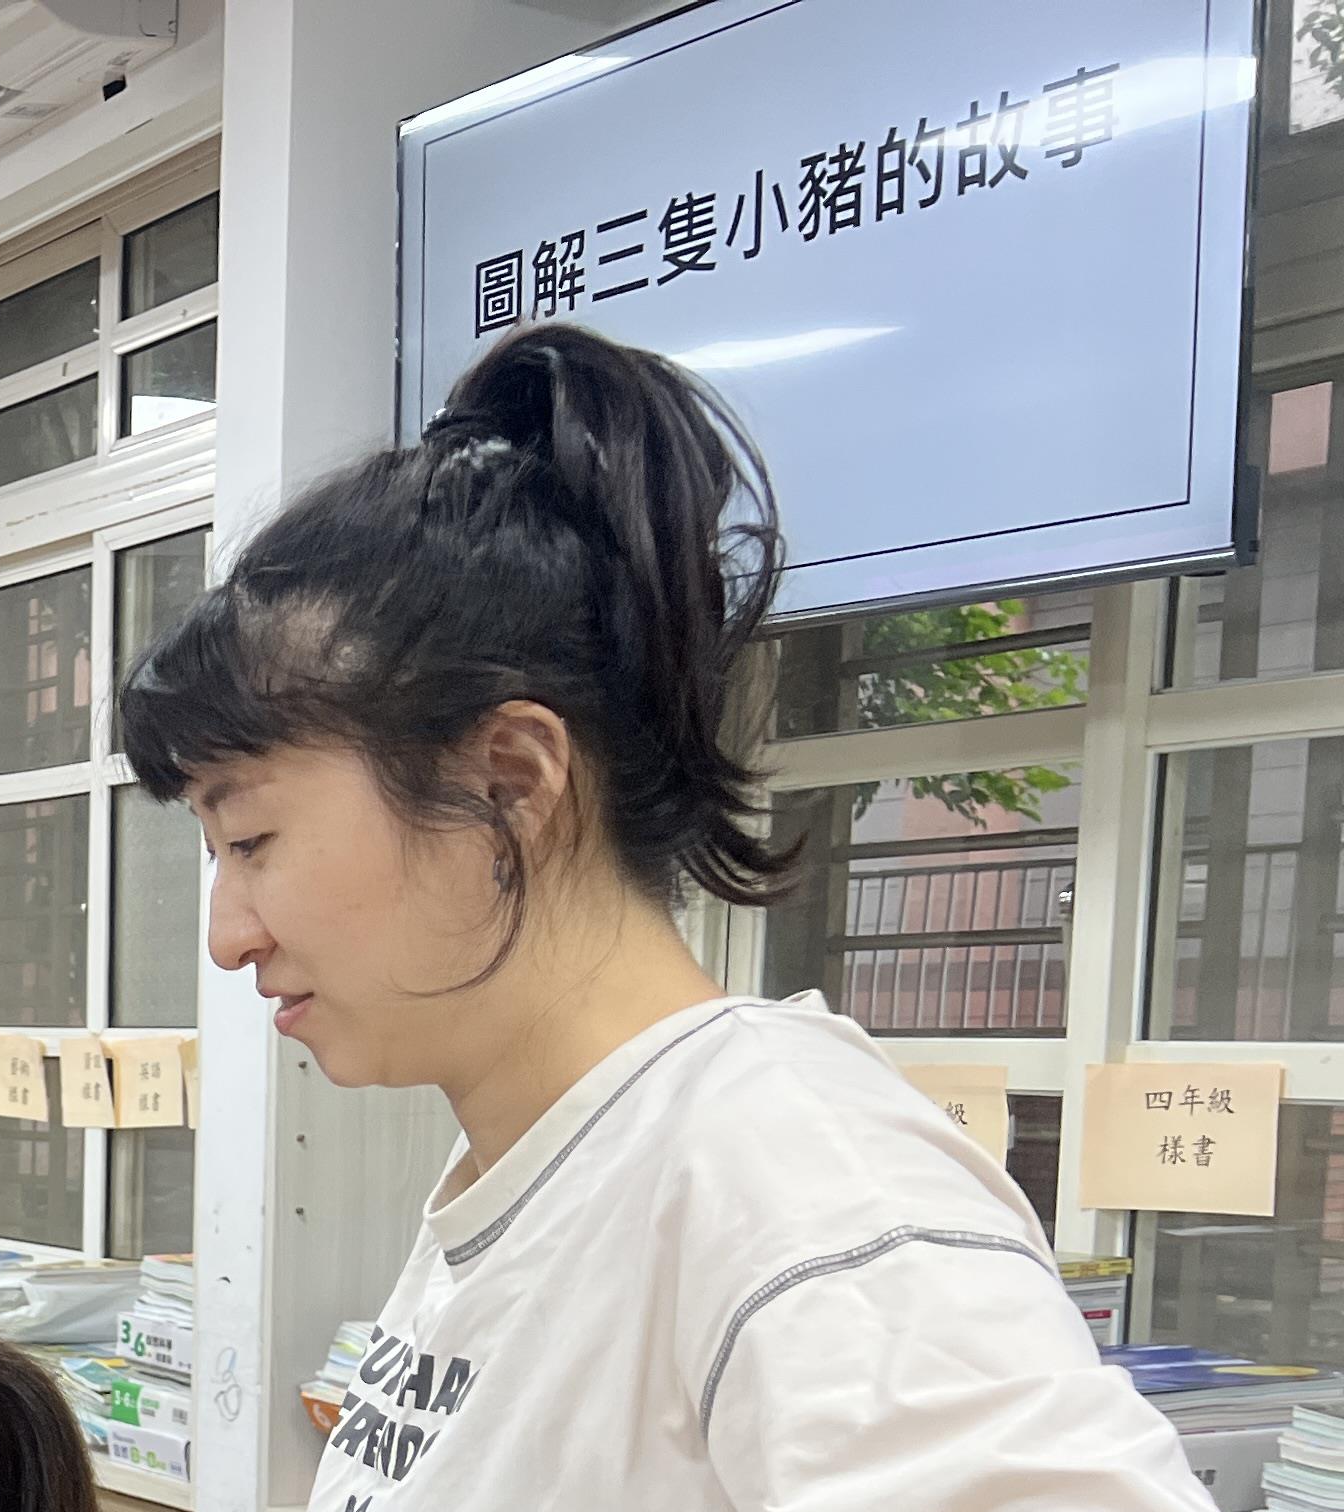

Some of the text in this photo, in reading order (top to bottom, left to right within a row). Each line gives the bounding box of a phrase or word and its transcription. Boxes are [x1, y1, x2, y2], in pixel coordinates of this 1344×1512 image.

[473, 62, 1122, 339] 圖解三隻小豬的故事
[1144, 1084, 1236, 1117] 四年級
[1155, 1134, 1216, 1168] 樣書
